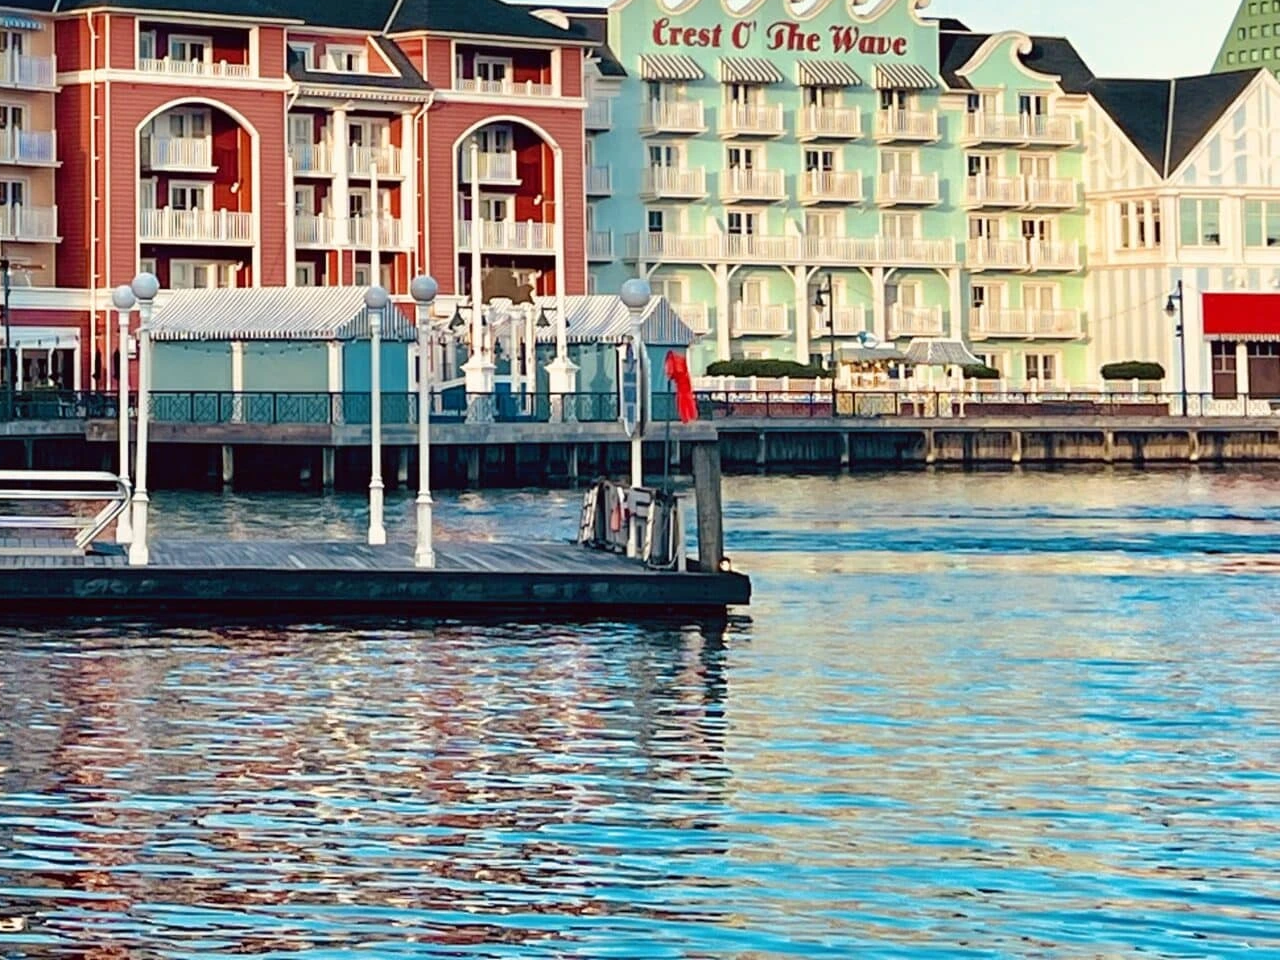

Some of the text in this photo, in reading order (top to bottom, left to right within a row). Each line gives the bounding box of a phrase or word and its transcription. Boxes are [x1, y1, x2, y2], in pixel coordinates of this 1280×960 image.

[652, 18, 907, 56] Crest O' The Wave
